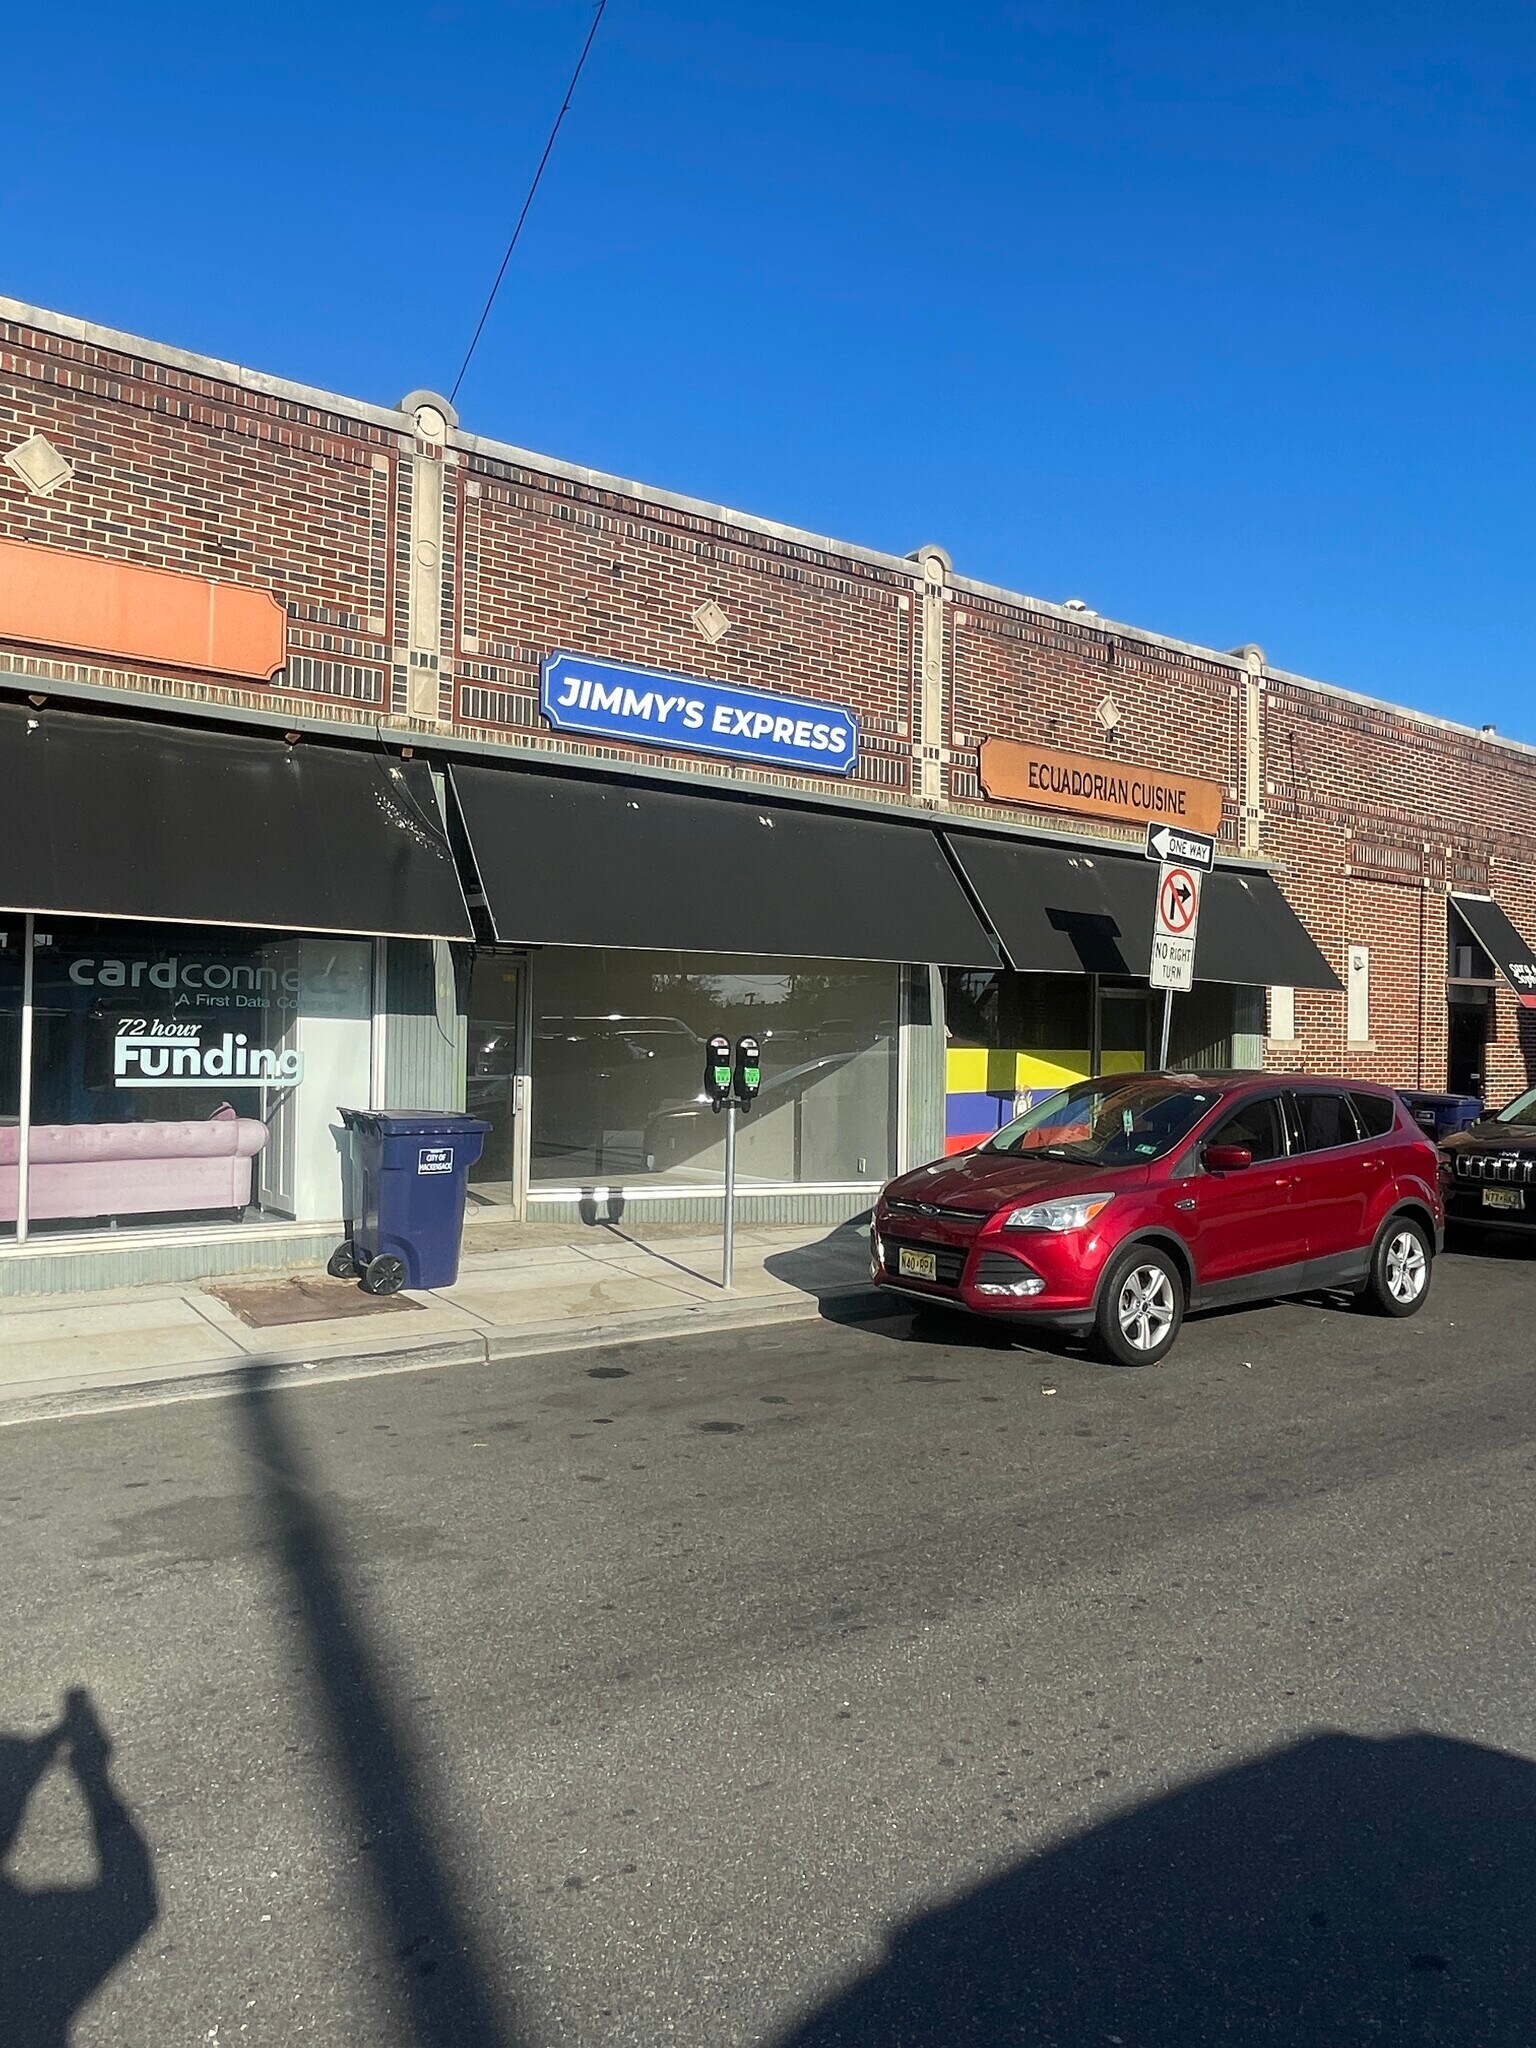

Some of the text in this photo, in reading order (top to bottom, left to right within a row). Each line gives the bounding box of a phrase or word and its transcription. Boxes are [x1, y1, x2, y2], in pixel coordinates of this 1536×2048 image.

[557, 676, 848, 753] JIMMY'S EXPRESS
[1028, 761, 1186, 815] ECUADORIAN CUISINE
[1169, 838, 1208, 860] ONE WAY
[1155, 942, 1191, 962] NO RIGHT
[69, 957, 348, 994] cardconne
[1162, 964, 1182, 980] TURN
[179, 993, 190, 1005] A
[197, 994, 230, 1007] First
[235, 995, 270, 1009] Data
[116, 1018, 202, 1037] 72 hour
[114, 1033, 304, 1087] Funding
